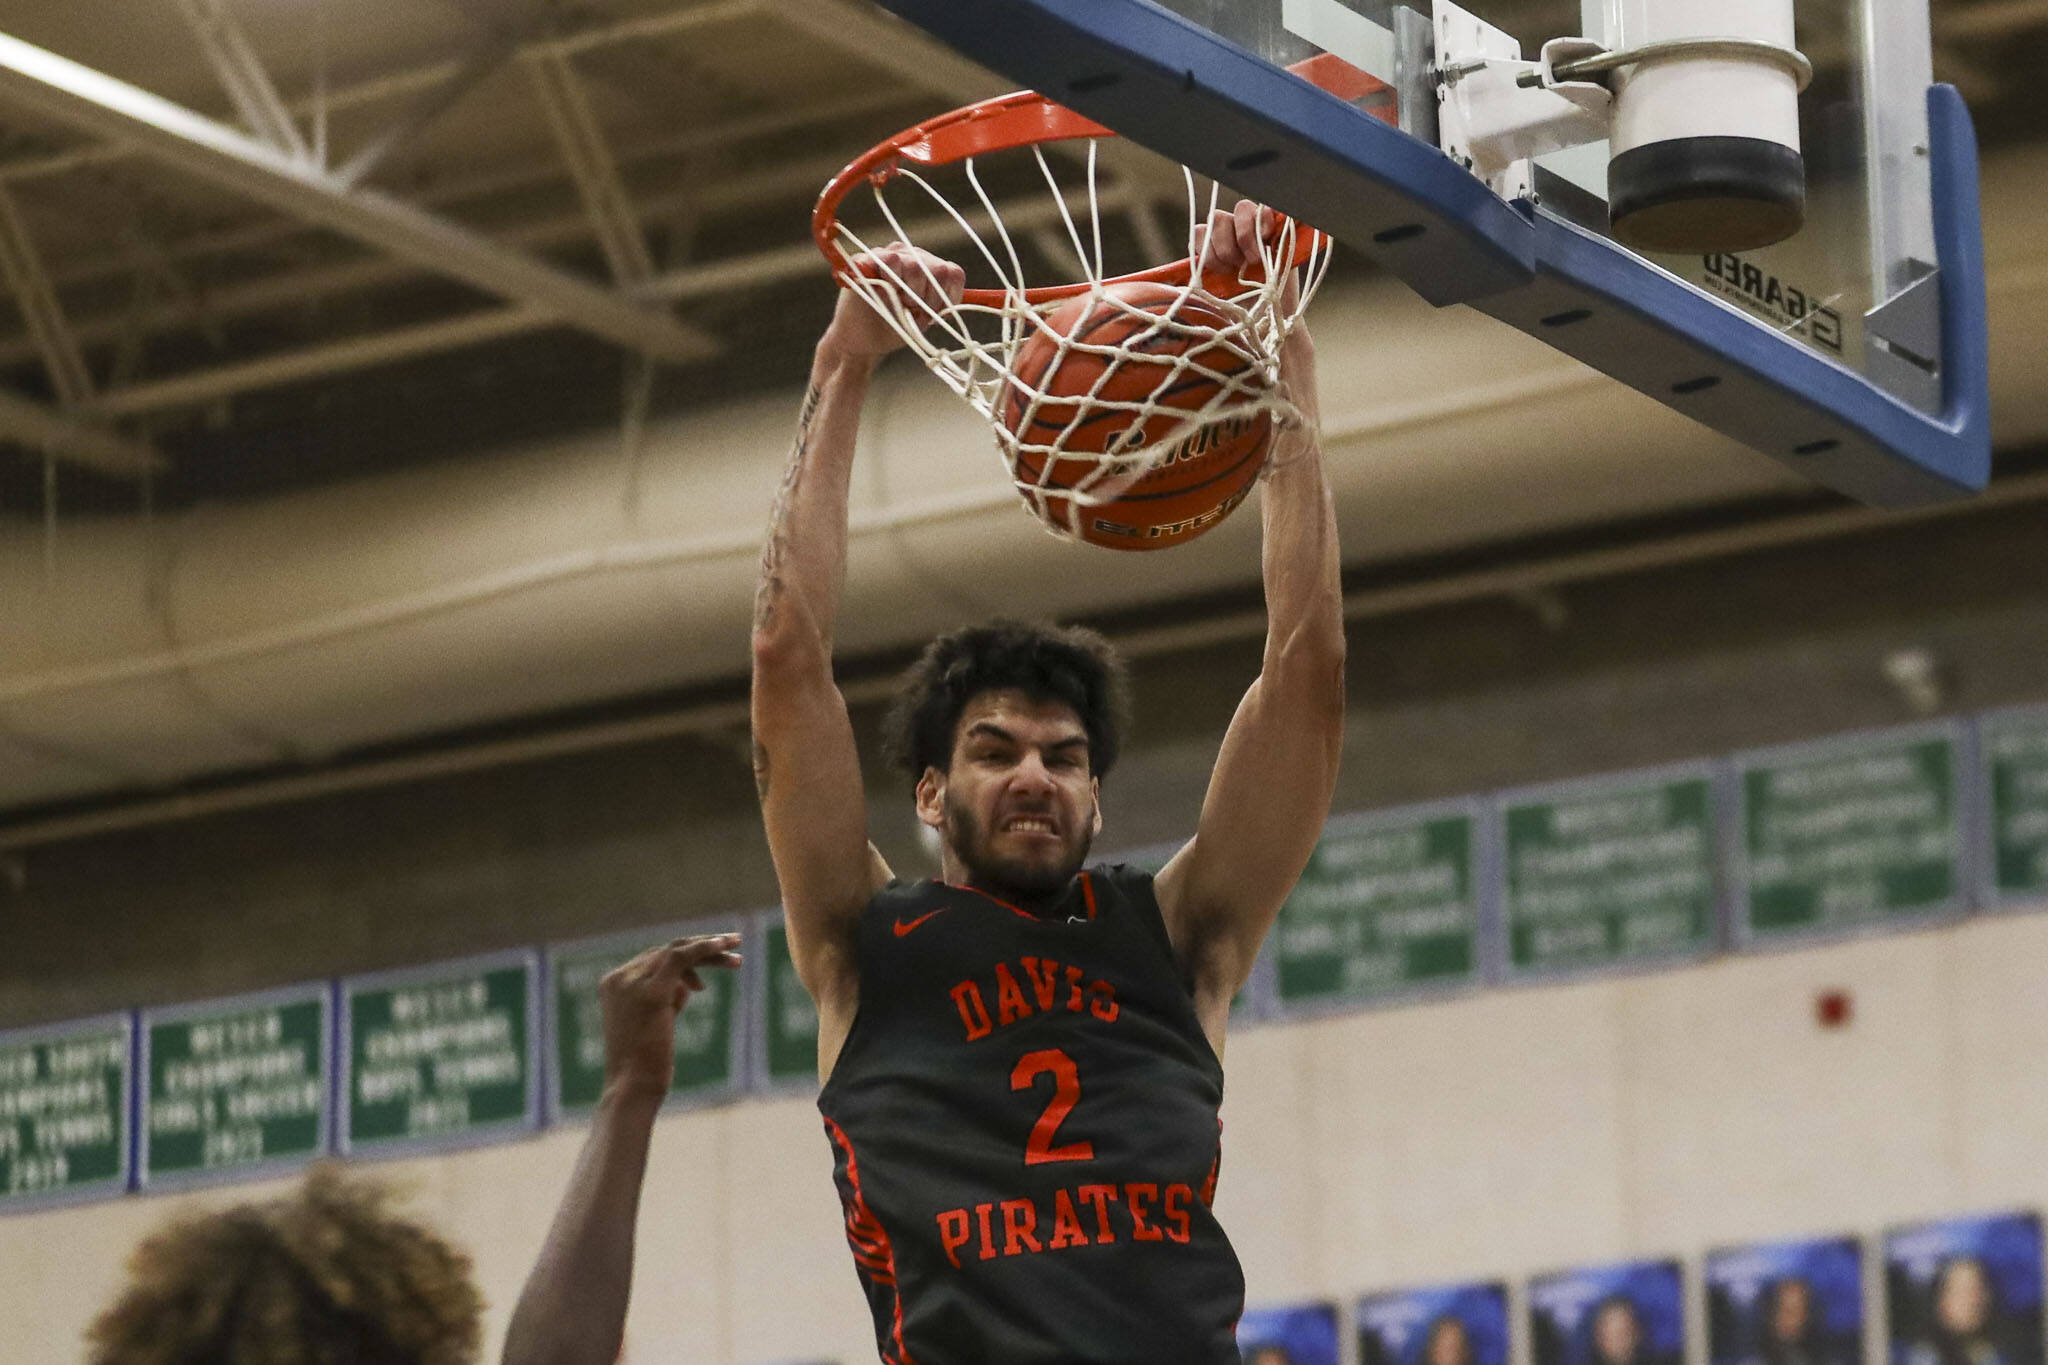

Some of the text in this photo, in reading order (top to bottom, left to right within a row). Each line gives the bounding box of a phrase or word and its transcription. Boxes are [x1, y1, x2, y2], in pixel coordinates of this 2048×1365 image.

[950, 957, 1119, 1041] DAVIS
[1010, 1048, 1094, 1166] 2
[936, 1183, 1192, 1269] PIRATES
